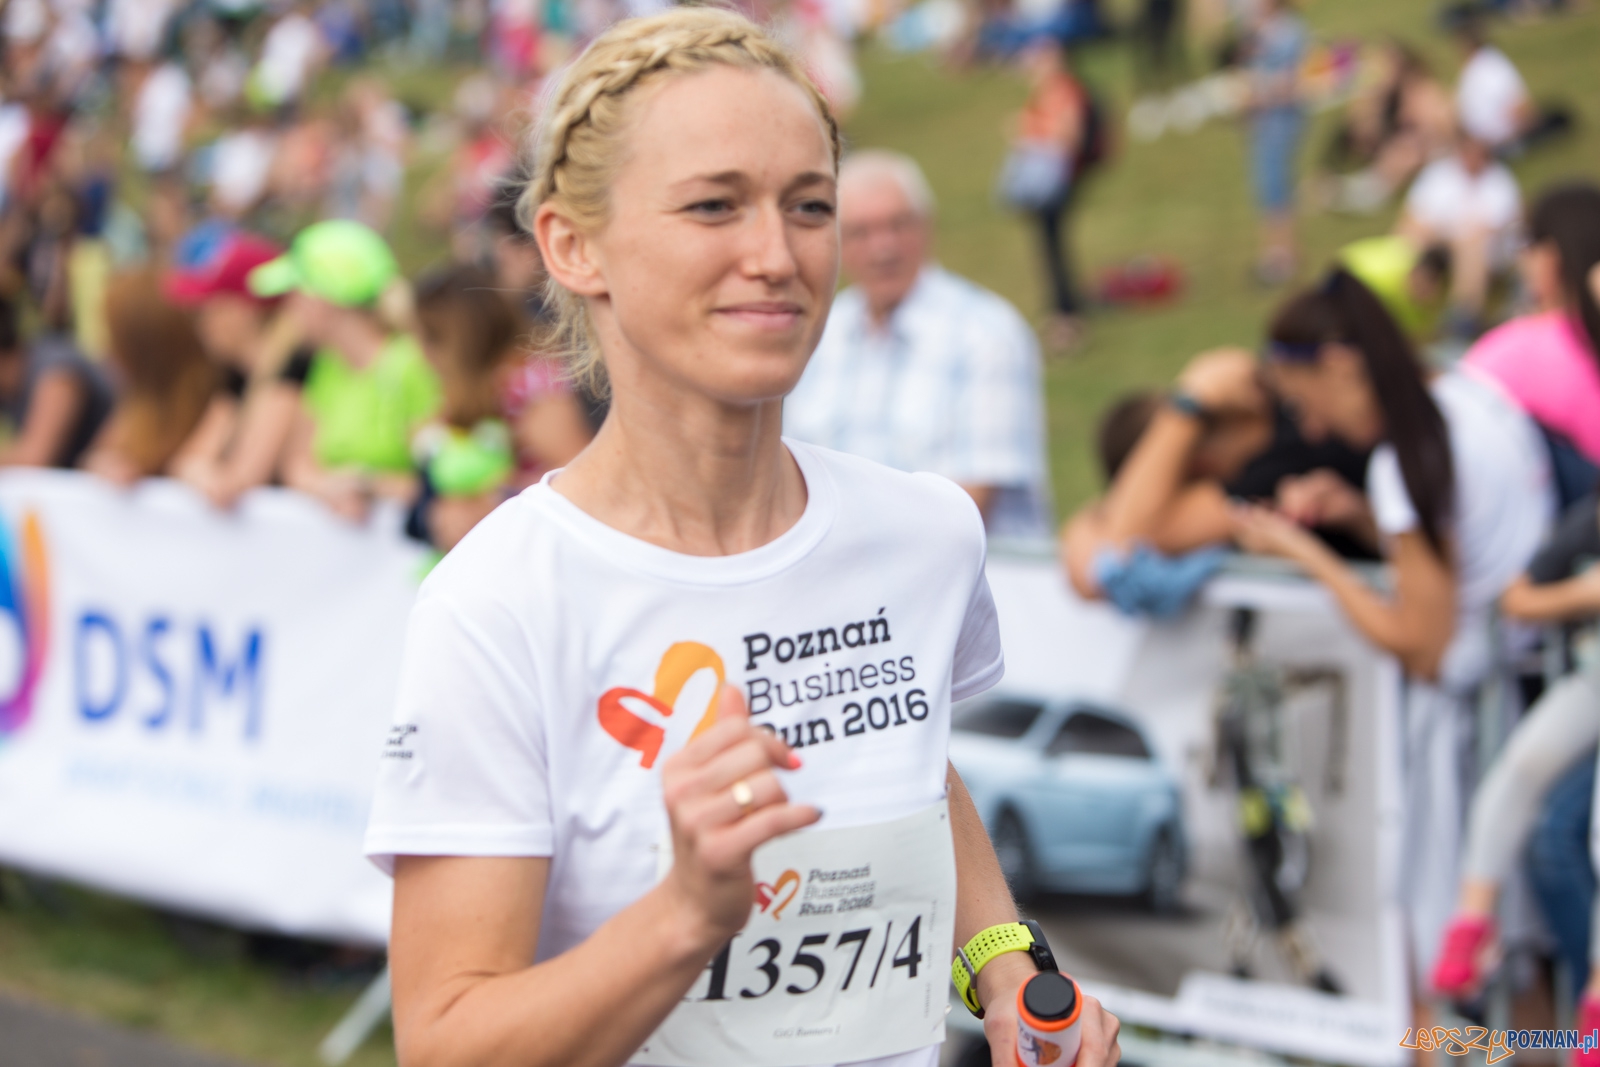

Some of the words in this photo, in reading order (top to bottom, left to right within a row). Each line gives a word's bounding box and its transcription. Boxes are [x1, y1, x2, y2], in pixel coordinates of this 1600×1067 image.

[743, 607, 891, 671] Poznań
[74, 608, 265, 740] DSM
[745, 655, 917, 716] Business
[756, 717, 834, 748] un
[842, 688, 929, 737] 2016
[798, 902, 834, 916] Run
[837, 894, 874, 912] 2016
[803, 881, 876, 899] Business
